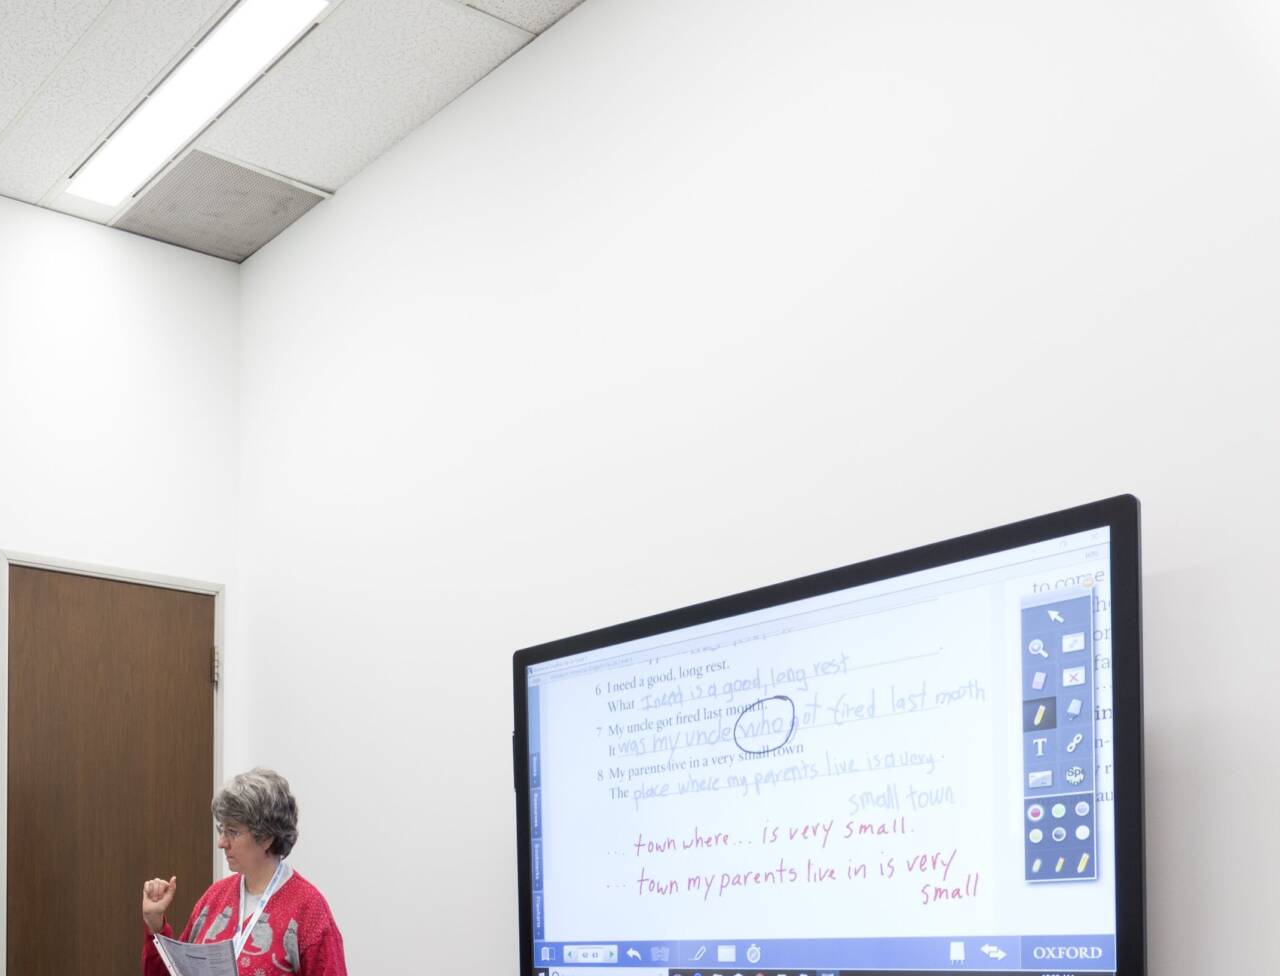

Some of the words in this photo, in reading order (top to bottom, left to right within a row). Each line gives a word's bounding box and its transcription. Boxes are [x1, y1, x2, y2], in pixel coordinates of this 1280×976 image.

[595, 684, 602, 696] 6
[613, 676, 637, 692] need
[639, 677, 645, 687] a
[679, 665, 703, 679] long
[706, 659, 730, 673] rest.
[608, 699, 635, 713] What
[813, 650, 849, 675] rest
[608, 724, 624, 740] My
[627, 717, 655, 734] uncle
[656, 715, 673, 732] got
[676, 709, 701, 725] fired
[703, 706, 722, 720] last
[653, 731, 680, 761] my
[739, 703, 785, 738] who
[826, 688, 877, 725] fired
[890, 681, 928, 712] last
[597, 769, 604, 781] 8
[609, 767, 626, 783] My
[628, 763, 666, 780] parents
[668, 759, 687, 773] live
[689, 755, 700, 768] in
[702, 757, 709, 766] a
[711, 752, 736, 768] very
[609, 786, 630, 800] The
[726, 774, 748, 797] my
[754, 761, 818, 795] parents
[848, 783, 901, 816] small
[906, 784, 956, 812] town
[634, 833, 677, 857] town
[762, 819, 779, 844] is
[789, 820, 834, 848] very
[637, 866, 678, 895] town
[688, 874, 716, 901] my
[719, 858, 798, 896] parents
[807, 858, 837, 883] live
[847, 858, 867, 880] in
[880, 851, 895, 879] is
[906, 849, 957, 881] very
[921, 872, 979, 905] small
[1033, 946, 1103, 960] OXFORD
